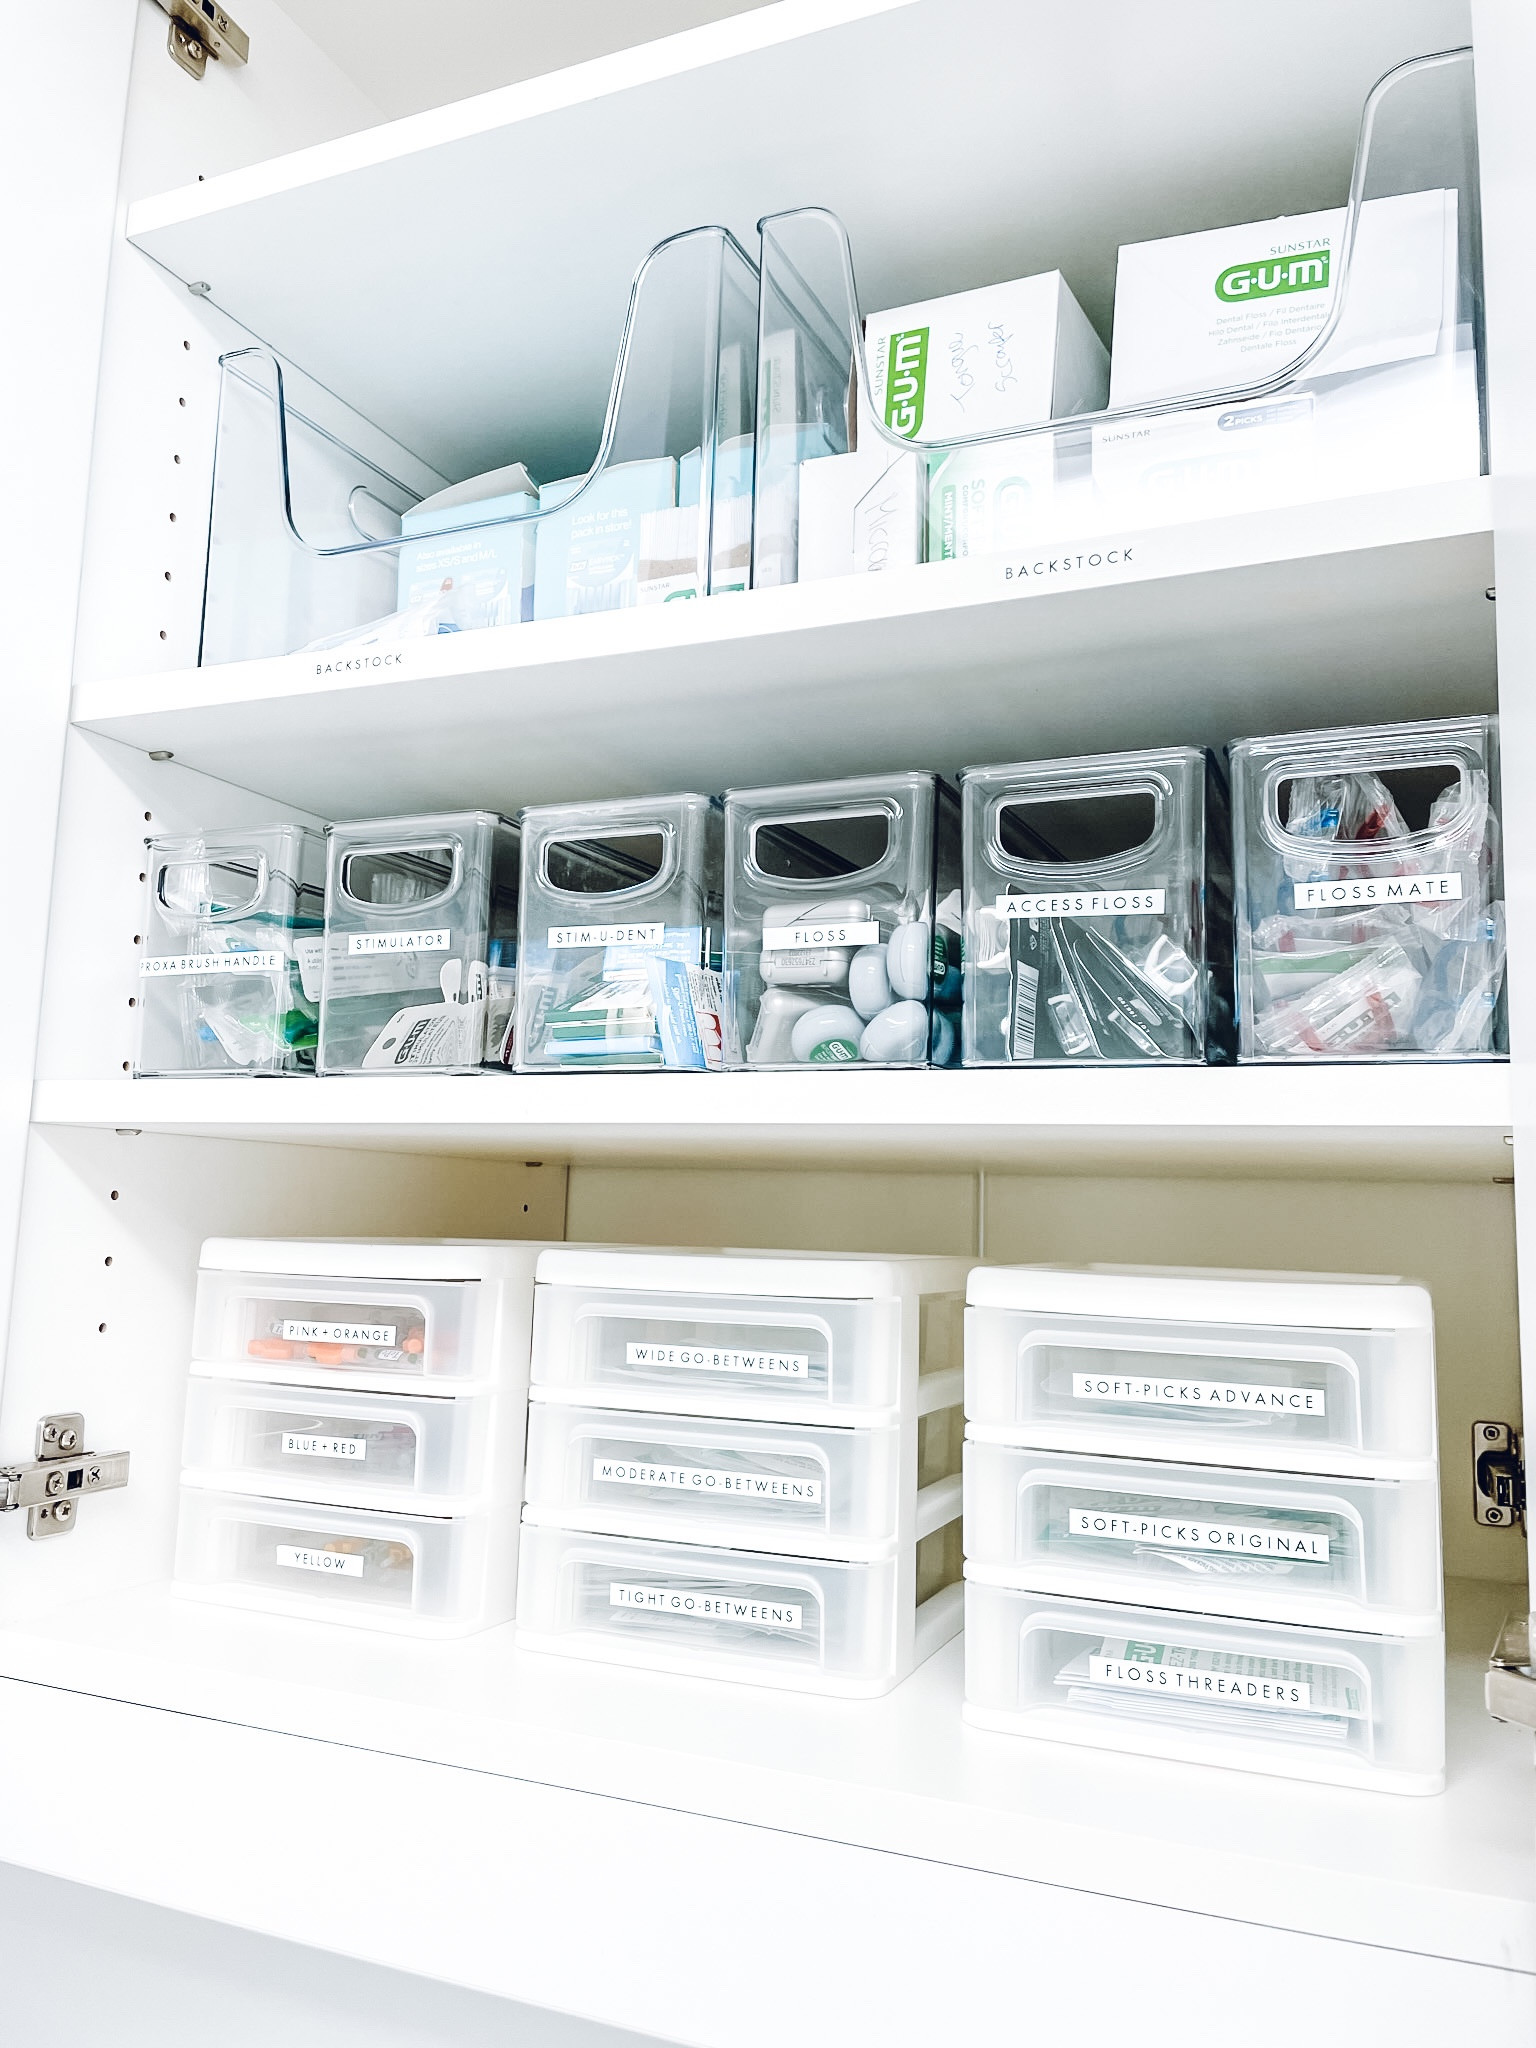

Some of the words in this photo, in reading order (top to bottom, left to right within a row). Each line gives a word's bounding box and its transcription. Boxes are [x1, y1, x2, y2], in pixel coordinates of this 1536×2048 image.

[1269, 237, 1331, 256] SUNSTAR
[1216, 314, 1243, 326] Dental
[1245, 310, 1267, 320] Floss
[1276, 306, 1287, 315] Fil
[1288, 302, 1325, 313] Dentaire
[1208, 328, 1224, 337] Hilo
[1226, 322, 1254, 334] Dental
[1263, 318, 1279, 327] Filo
[1217, 333, 1260, 346] Zahnseide
[1240, 341, 1272, 352] Dentale
[1275, 337, 1297, 347] Floss
[874, 336, 886, 396] SUNSTAR
[1102, 429, 1151, 443] SUNSTAR
[572, 514, 595, 526] Look
[597, 511, 609, 520] for
[611, 508, 628, 518] this
[571, 526, 594, 539] pack
[595, 525, 604, 534] in
[416, 550, 436, 560] Also
[1006, 548, 1134, 580] BACKSTOCK
[641, 582, 670, 593] SUNSTAR
[316, 653, 402, 675] BACKSTOCK
[1307, 884, 1377, 902] FLOSS
[1387, 878, 1451, 897] MATE
[1007, 898, 1083, 913] ACCESS
[1092, 896, 1153, 910] FLOSS
[356, 934, 443, 949] STIMULATOR
[556, 929, 656, 944] STIM-U-DENT
[795, 929, 847, 943] FLOSS
[181, 957, 219, 969] BRUSH
[224, 954, 276, 967] HANDLE
[290, 1325, 318, 1337] PINK
[333, 1328, 389, 1341] ORANGE
[636, 1349, 674, 1362] WIDE
[681, 1352, 800, 1372] GO-BETWEENS
[1084, 1380, 1201, 1400] SOFT-PICKS
[1210, 1389, 1314, 1409] ADVANCE
[289, 1438, 317, 1451] BLUE
[322, 1443, 328, 1451] +
[334, 1443, 356, 1455] RED
[602, 1465, 685, 1484] MODERATE
[692, 1474, 814, 1497] GO-BETWEENS
[1081, 1516, 1200, 1541] SOFT-PICKS
[1208, 1530, 1318, 1555] ORIGINAL
[295, 1551, 345, 1569] YELLOW
[619, 1589, 665, 1606] TIGHT
[671, 1596, 793, 1623] GO-BETWEENS
[1106, 1664, 1167, 1685] FLOSS
[1176, 1673, 1300, 1702] THREADERS
